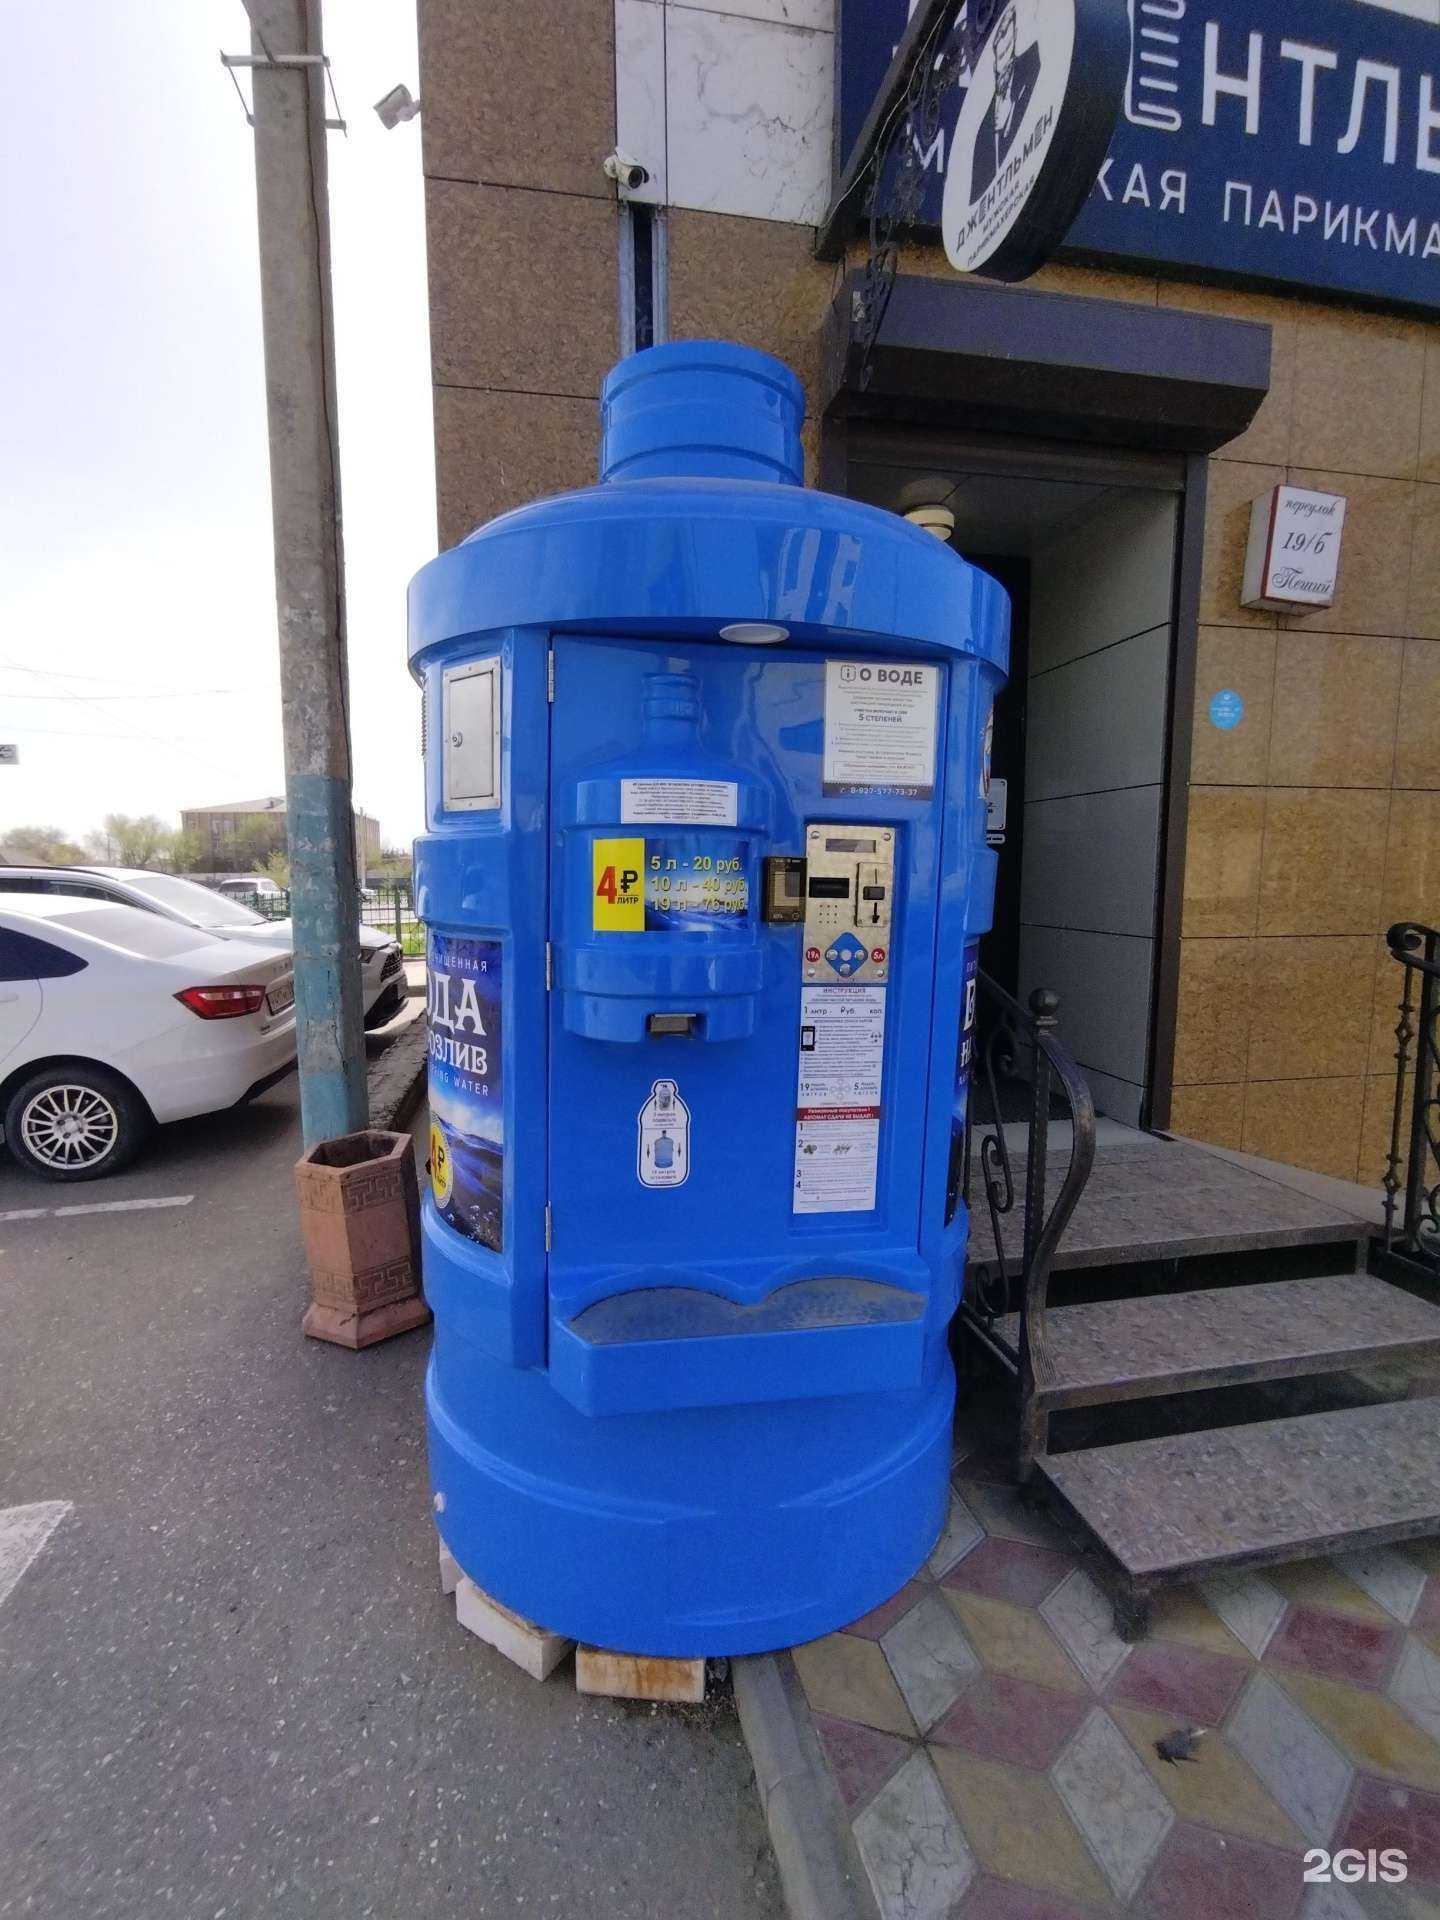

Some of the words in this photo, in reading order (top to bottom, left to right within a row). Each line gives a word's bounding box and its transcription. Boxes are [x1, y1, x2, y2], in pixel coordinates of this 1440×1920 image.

[956, 105, 1055, 254] ДЖЕНТЛЬМЕН
[1285, 498, 1341, 518] переулок
[859, 667, 872, 682] О
[877, 668, 924, 687] ВОДЕ
[650, 856, 661, 871] 5
[665, 858, 677, 870] л
[693, 856, 712, 871] 20
[716, 857, 743, 873] руб.
[596, 865, 618, 905] 4
[651, 876, 671, 892] 10
[702, 877, 721, 892] 40
[651, 897, 671, 912] 19
[432, 953, 487, 973] ЧИЩЕННАЯ
[453, 1076, 489, 1097] WATER
